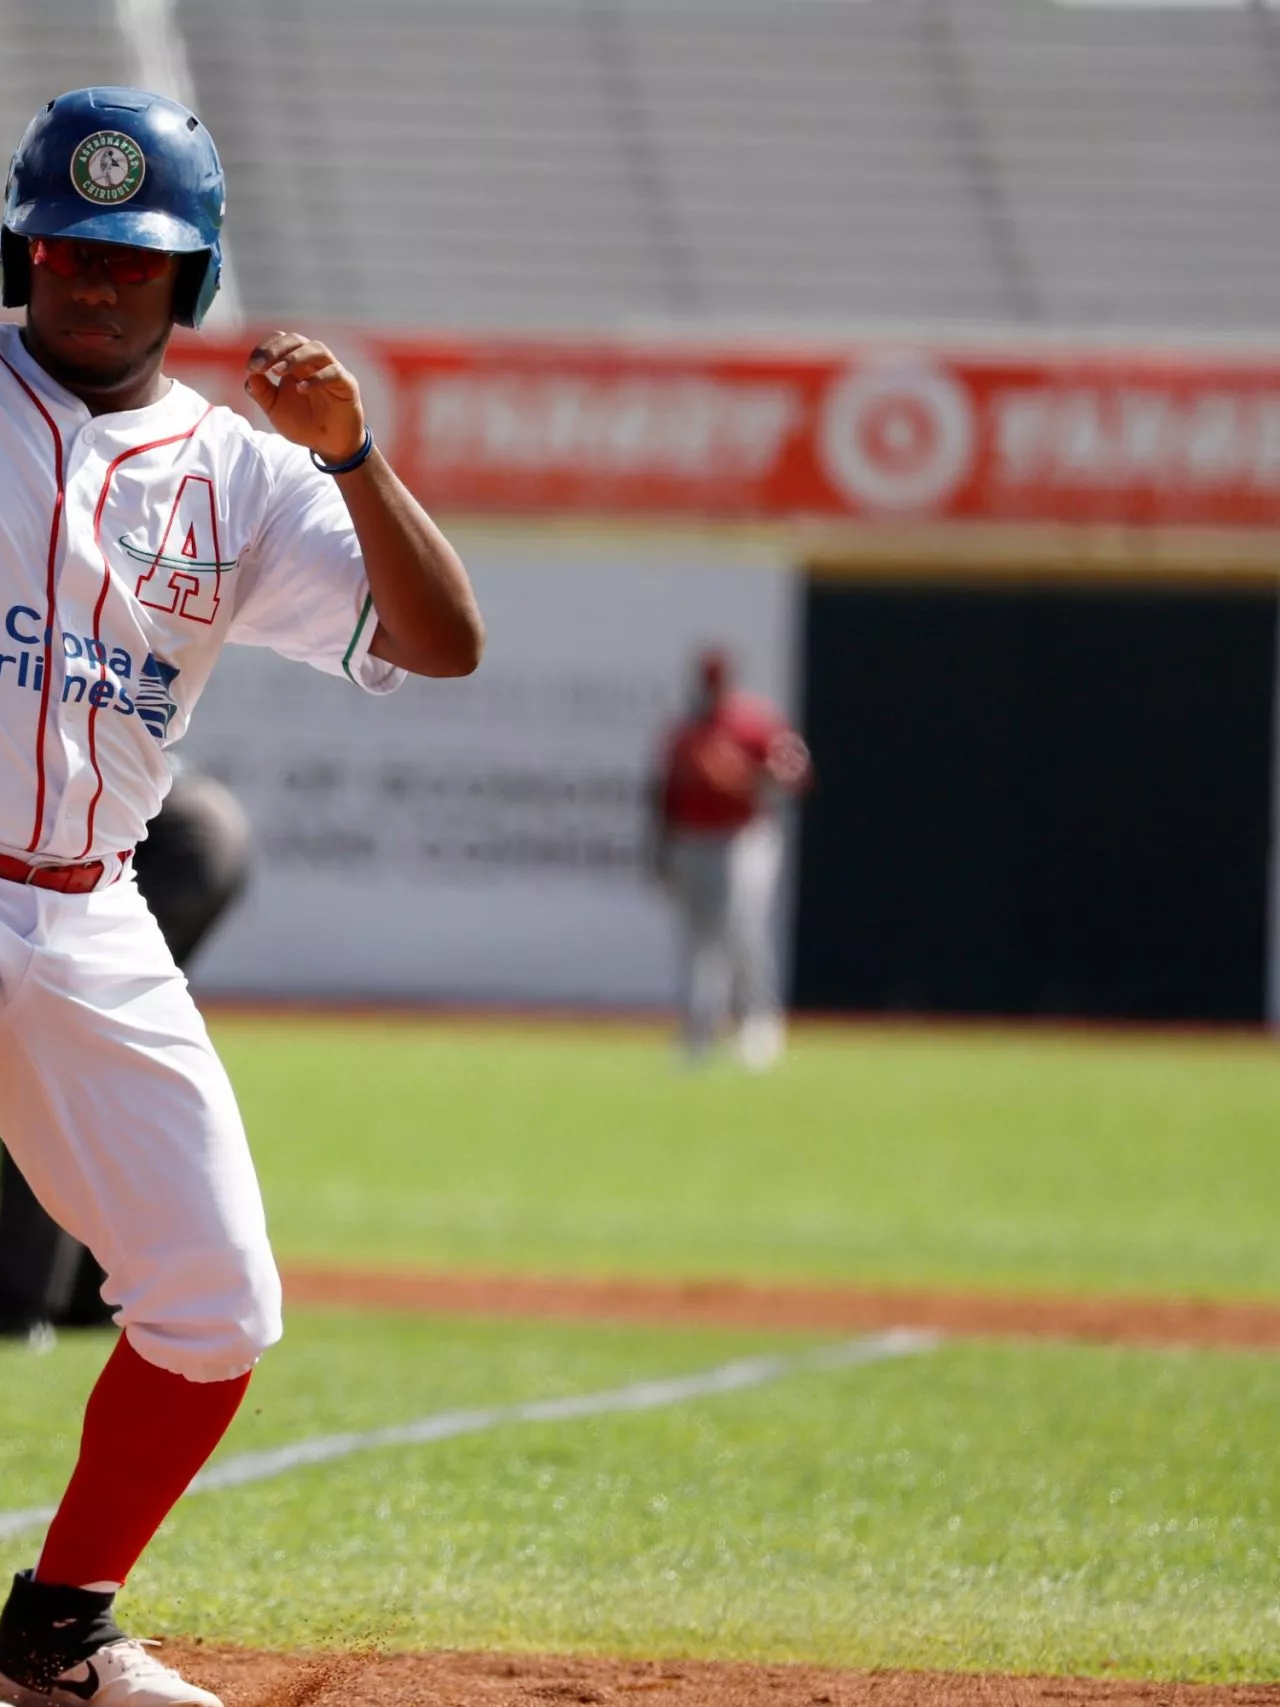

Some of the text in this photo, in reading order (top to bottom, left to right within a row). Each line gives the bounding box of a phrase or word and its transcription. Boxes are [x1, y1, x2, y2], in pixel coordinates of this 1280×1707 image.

[80, 137, 139, 169] ASTRONAUTAS
[135, 475, 221, 625] A
[6, 605, 132, 679] Copa
